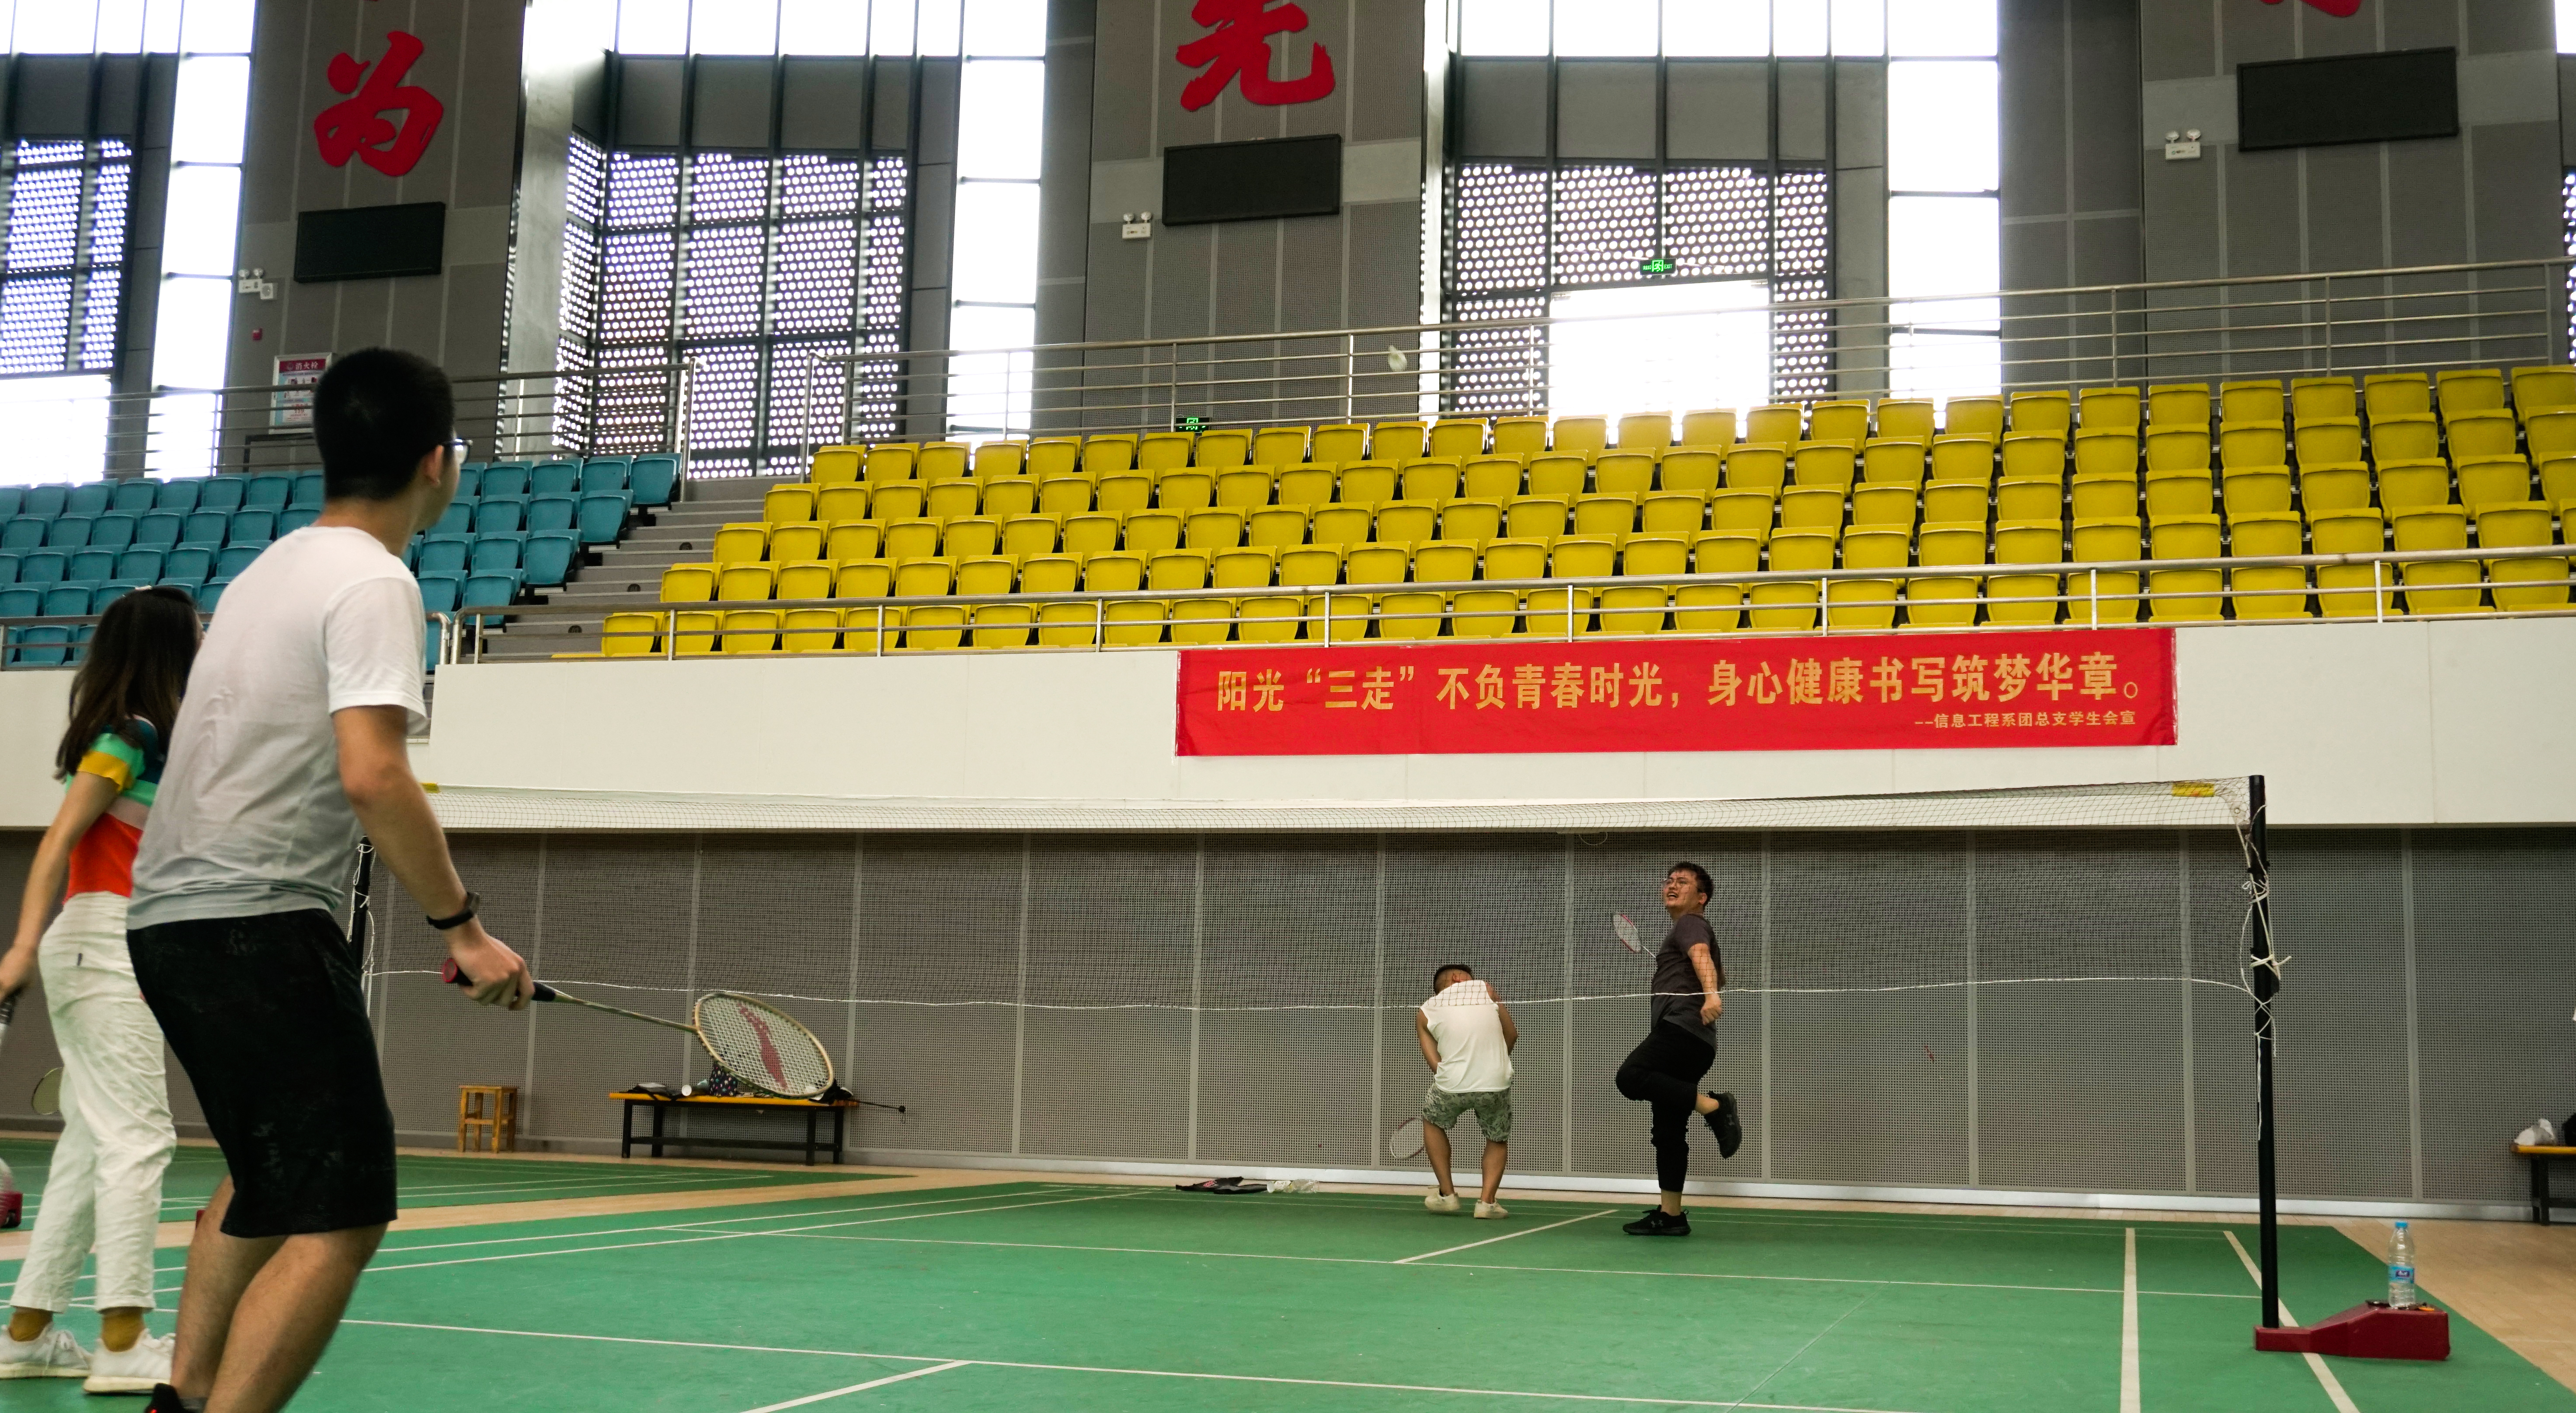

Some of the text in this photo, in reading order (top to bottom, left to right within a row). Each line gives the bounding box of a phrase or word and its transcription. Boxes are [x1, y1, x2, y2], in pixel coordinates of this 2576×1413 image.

[313, 31, 443, 177] 为
[295, 362, 319, 370] 消火栓
